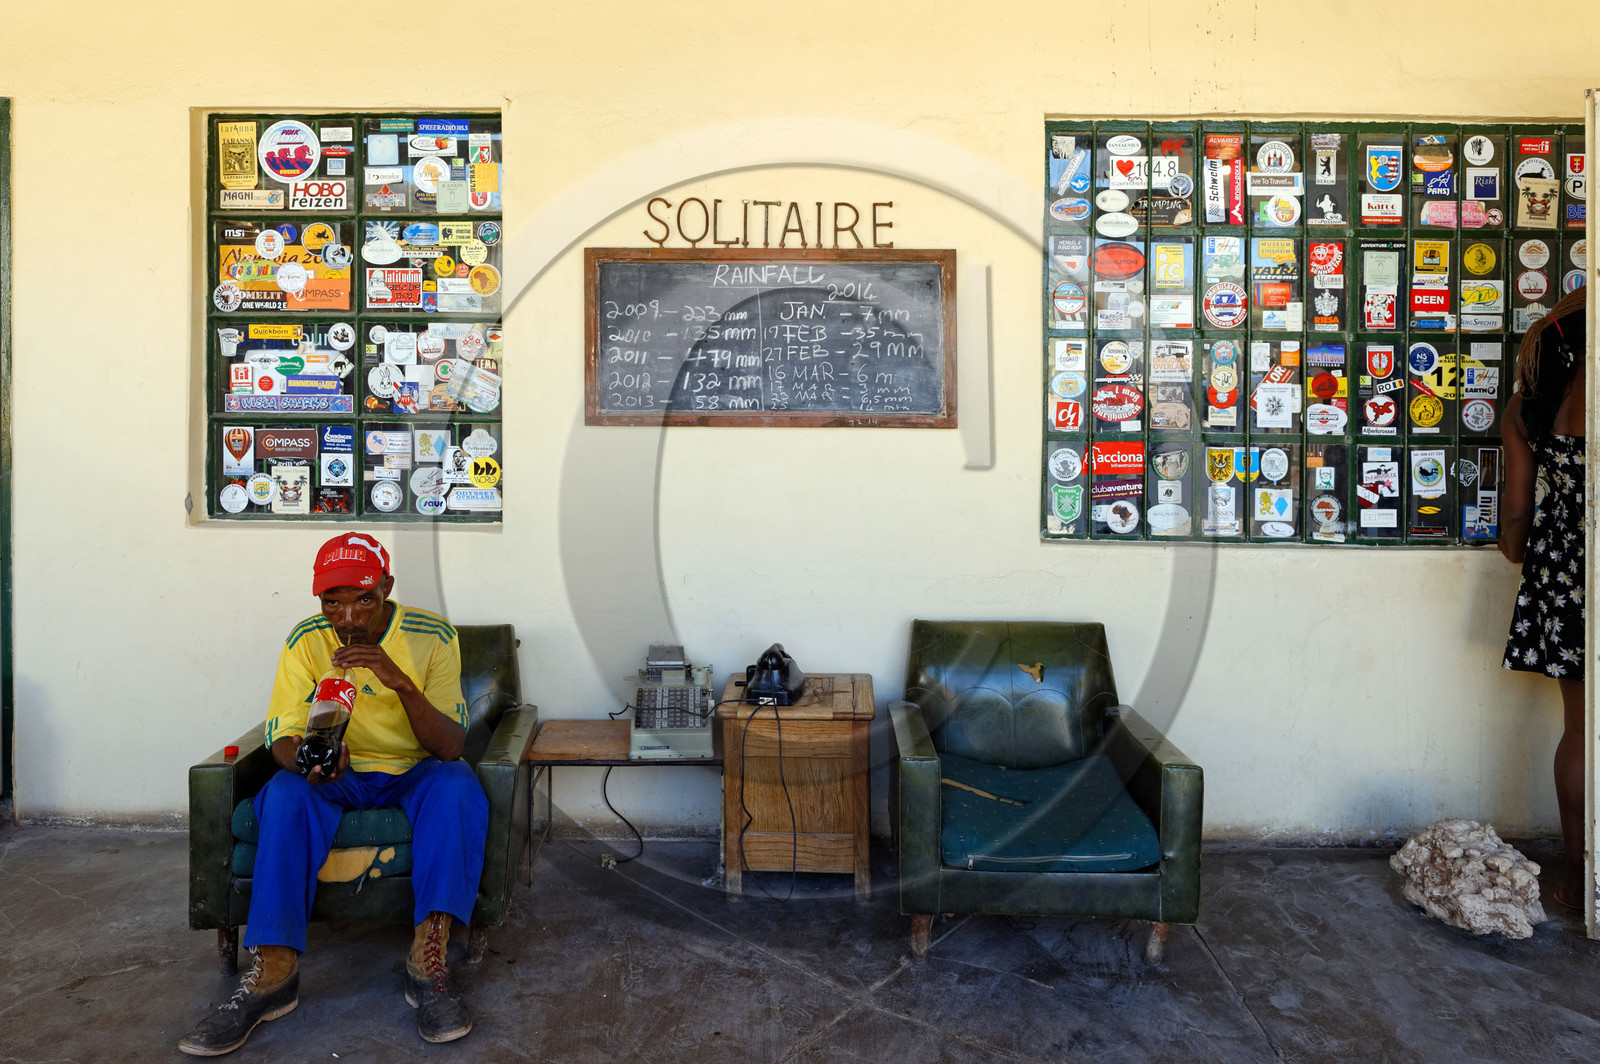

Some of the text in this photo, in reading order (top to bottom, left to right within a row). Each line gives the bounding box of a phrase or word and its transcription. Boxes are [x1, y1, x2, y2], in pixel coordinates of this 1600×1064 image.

[281, 128, 300, 136] PINK
[1208, 160, 1219, 202] Schwelm
[223, 191, 254, 202] MAGNI
[293, 182, 345, 198] HOBO
[291, 196, 343, 208] reizen
[1367, 202, 1396, 210] karoo
[643, 197, 893, 248] SOLITAIRE
[224, 229, 245, 237] msi
[385, 270, 421, 283] latitudini
[712, 264, 826, 287] RAINFALL
[1252, 266, 1299, 275] TATRA
[387, 282, 421, 291] anche
[826, 282, 878, 301] 2014
[394, 291, 414, 299] noi
[1415, 295, 1444, 304] DEEN
[682, 305, 722, 322] 223
[724, 311, 748, 321] mm
[859, 305, 874, 321] 7
[878, 308, 911, 324] mm
[1314, 316, 1340, 324] RIESA
[607, 325, 757, 344] 2010 135 mm
[781, 324, 828, 344] FEB
[853, 326, 880, 340] 35
[607, 346, 647, 366] 2011
[735, 351, 761, 368] mm
[786, 344, 830, 361] FEB
[852, 341, 882, 360] 29
[767, 364, 786, 381] 16
[857, 362, 869, 383] 6
[1430, 366, 1465, 387] 12
[608, 370, 763, 393] 2012 132 mm
[1378, 383, 1391, 393] RO
[280, 395, 329, 410] SHARKS
[611, 392, 655, 408] 2013
[728, 395, 760, 410] mm
[1097, 451, 1143, 463] acciona
[1091, 483, 1143, 494] clubaventure
[423, 498, 444, 508] saur
[1479, 496, 1492, 524] Zulu
